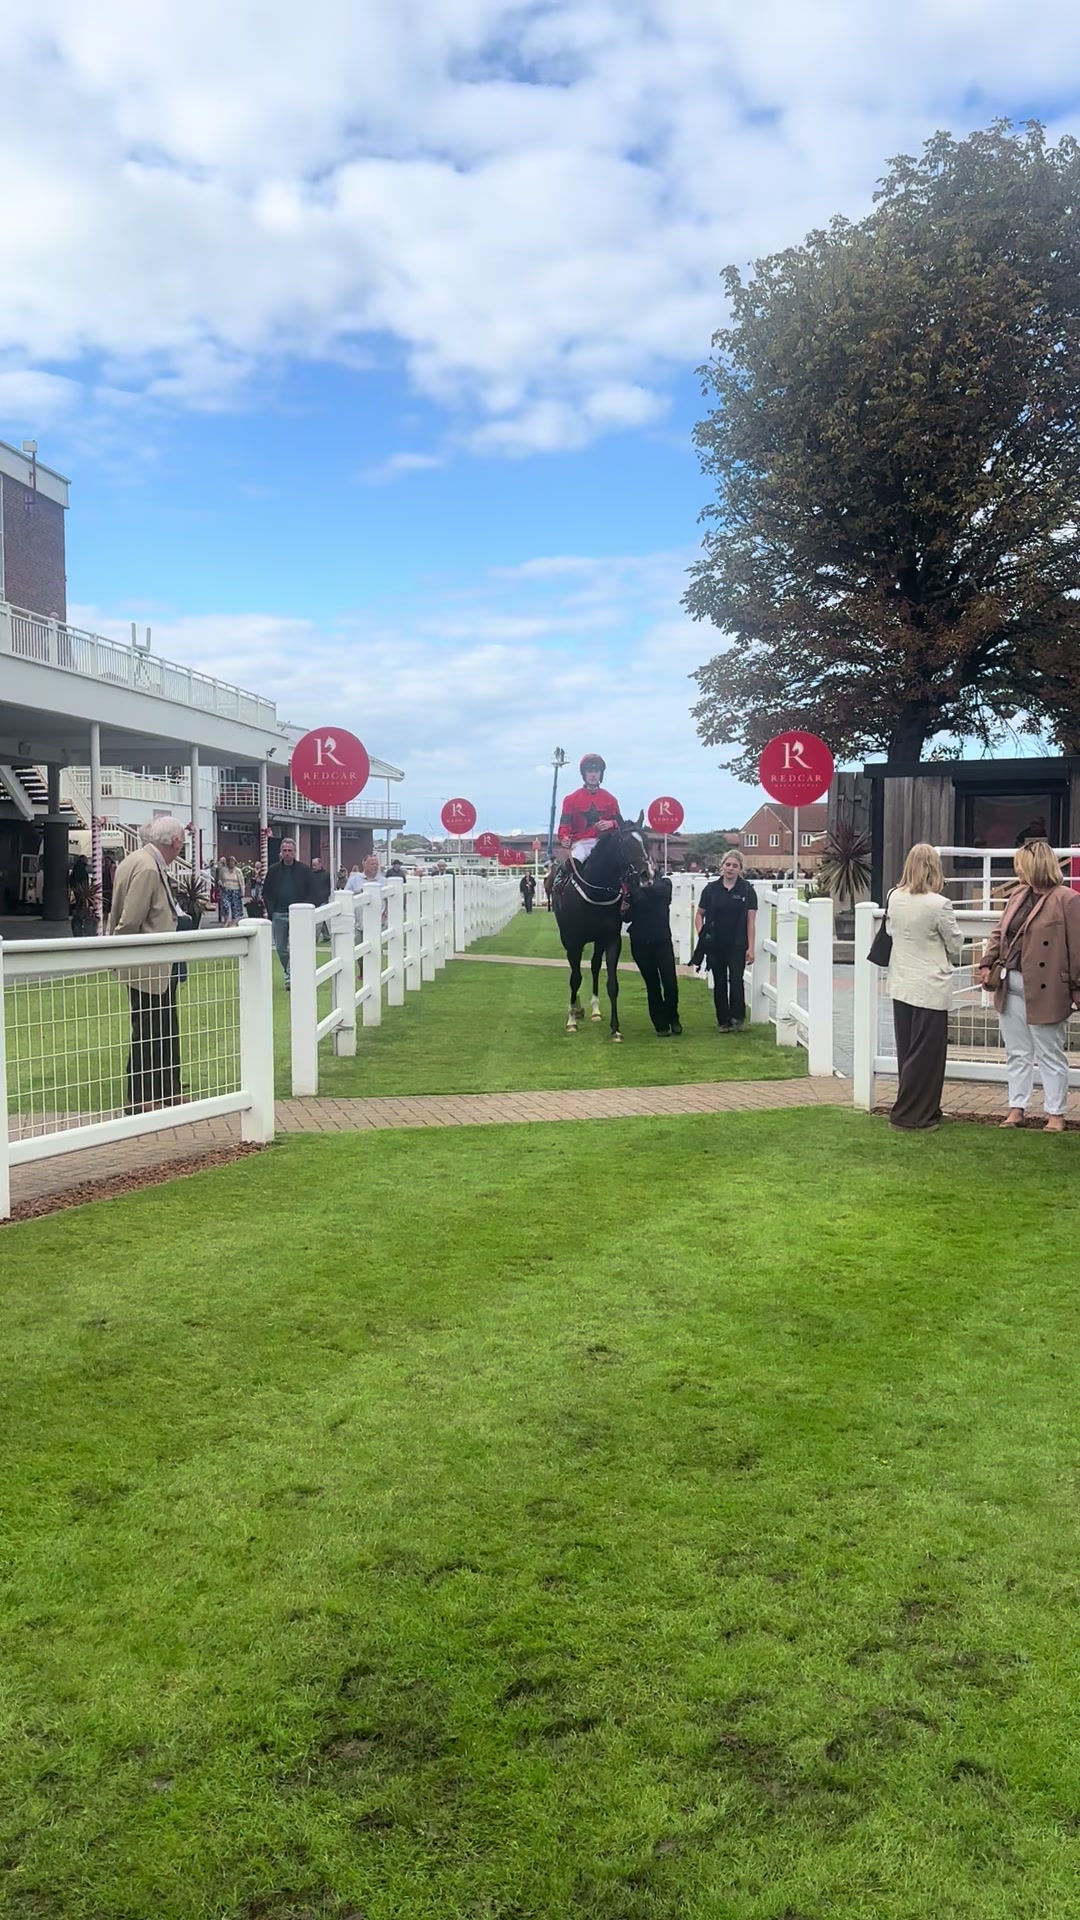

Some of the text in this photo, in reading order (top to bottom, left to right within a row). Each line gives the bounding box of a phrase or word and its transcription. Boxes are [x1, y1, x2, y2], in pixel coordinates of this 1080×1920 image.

[313, 735, 347, 767] R
[781, 740, 813, 769] R
[303, 772, 357, 780] REDCAR
[770, 774, 823, 782] REDCAR
